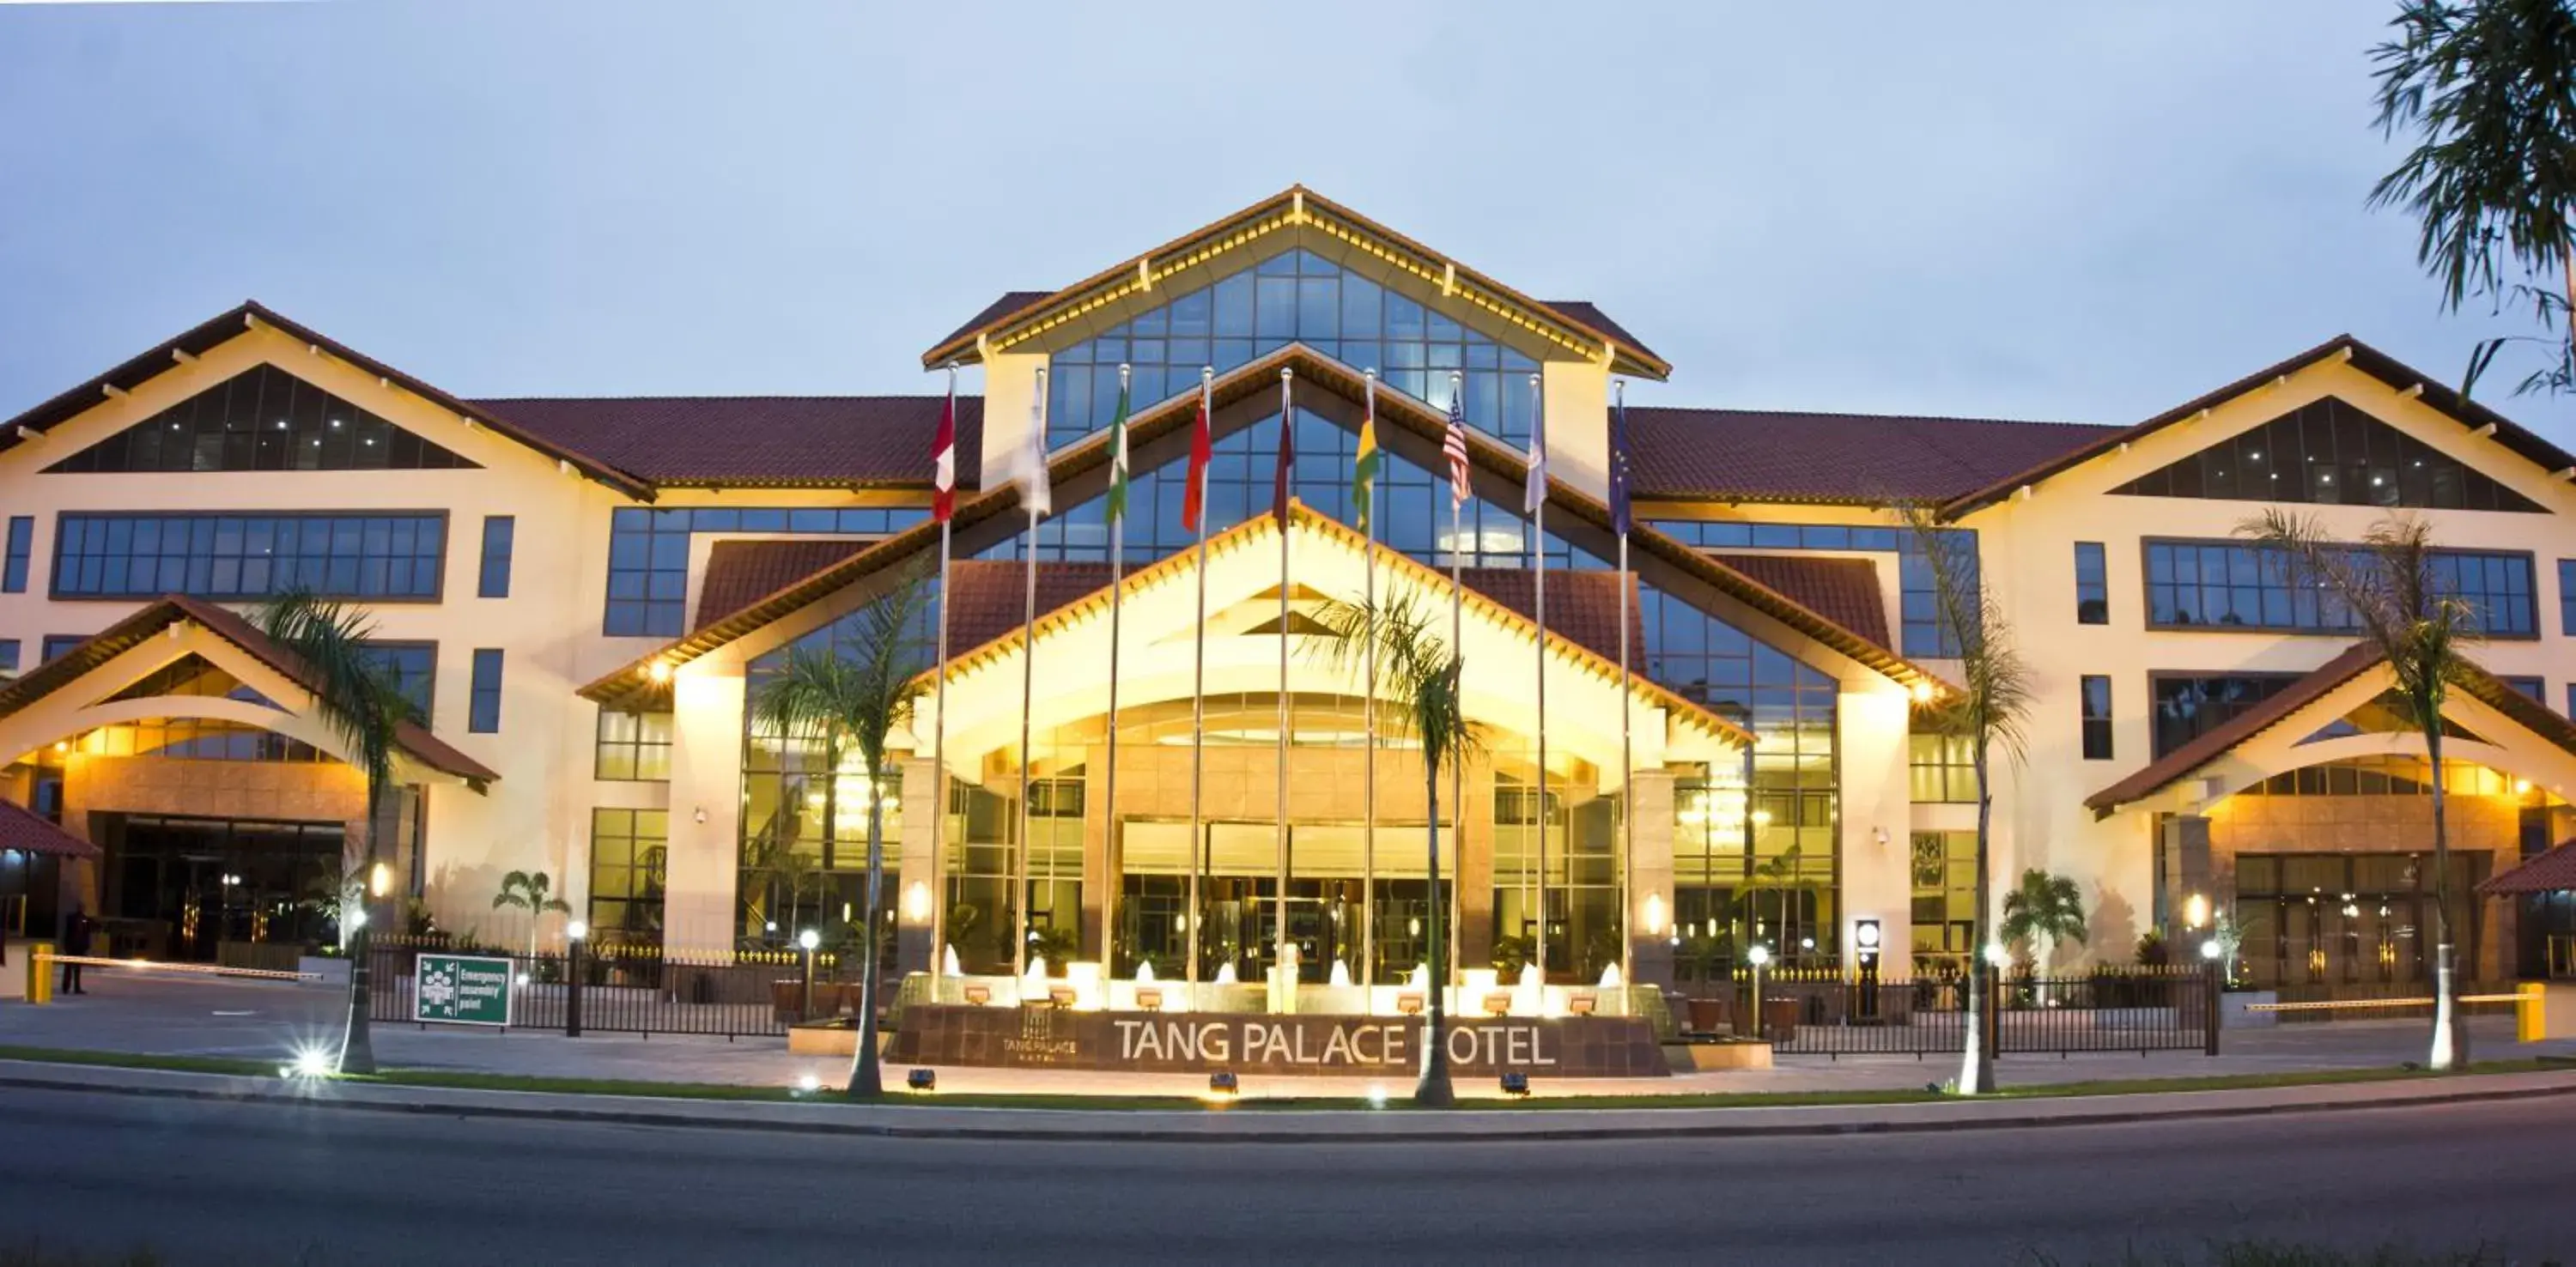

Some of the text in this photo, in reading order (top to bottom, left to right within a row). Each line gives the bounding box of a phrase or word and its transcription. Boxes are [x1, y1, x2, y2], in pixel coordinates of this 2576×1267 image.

[460, 968, 506, 986] Emergency
[459, 997, 482, 1011] point
[1114, 1020, 1230, 1062] TANG
[1242, 1022, 1406, 1064] PALACE
